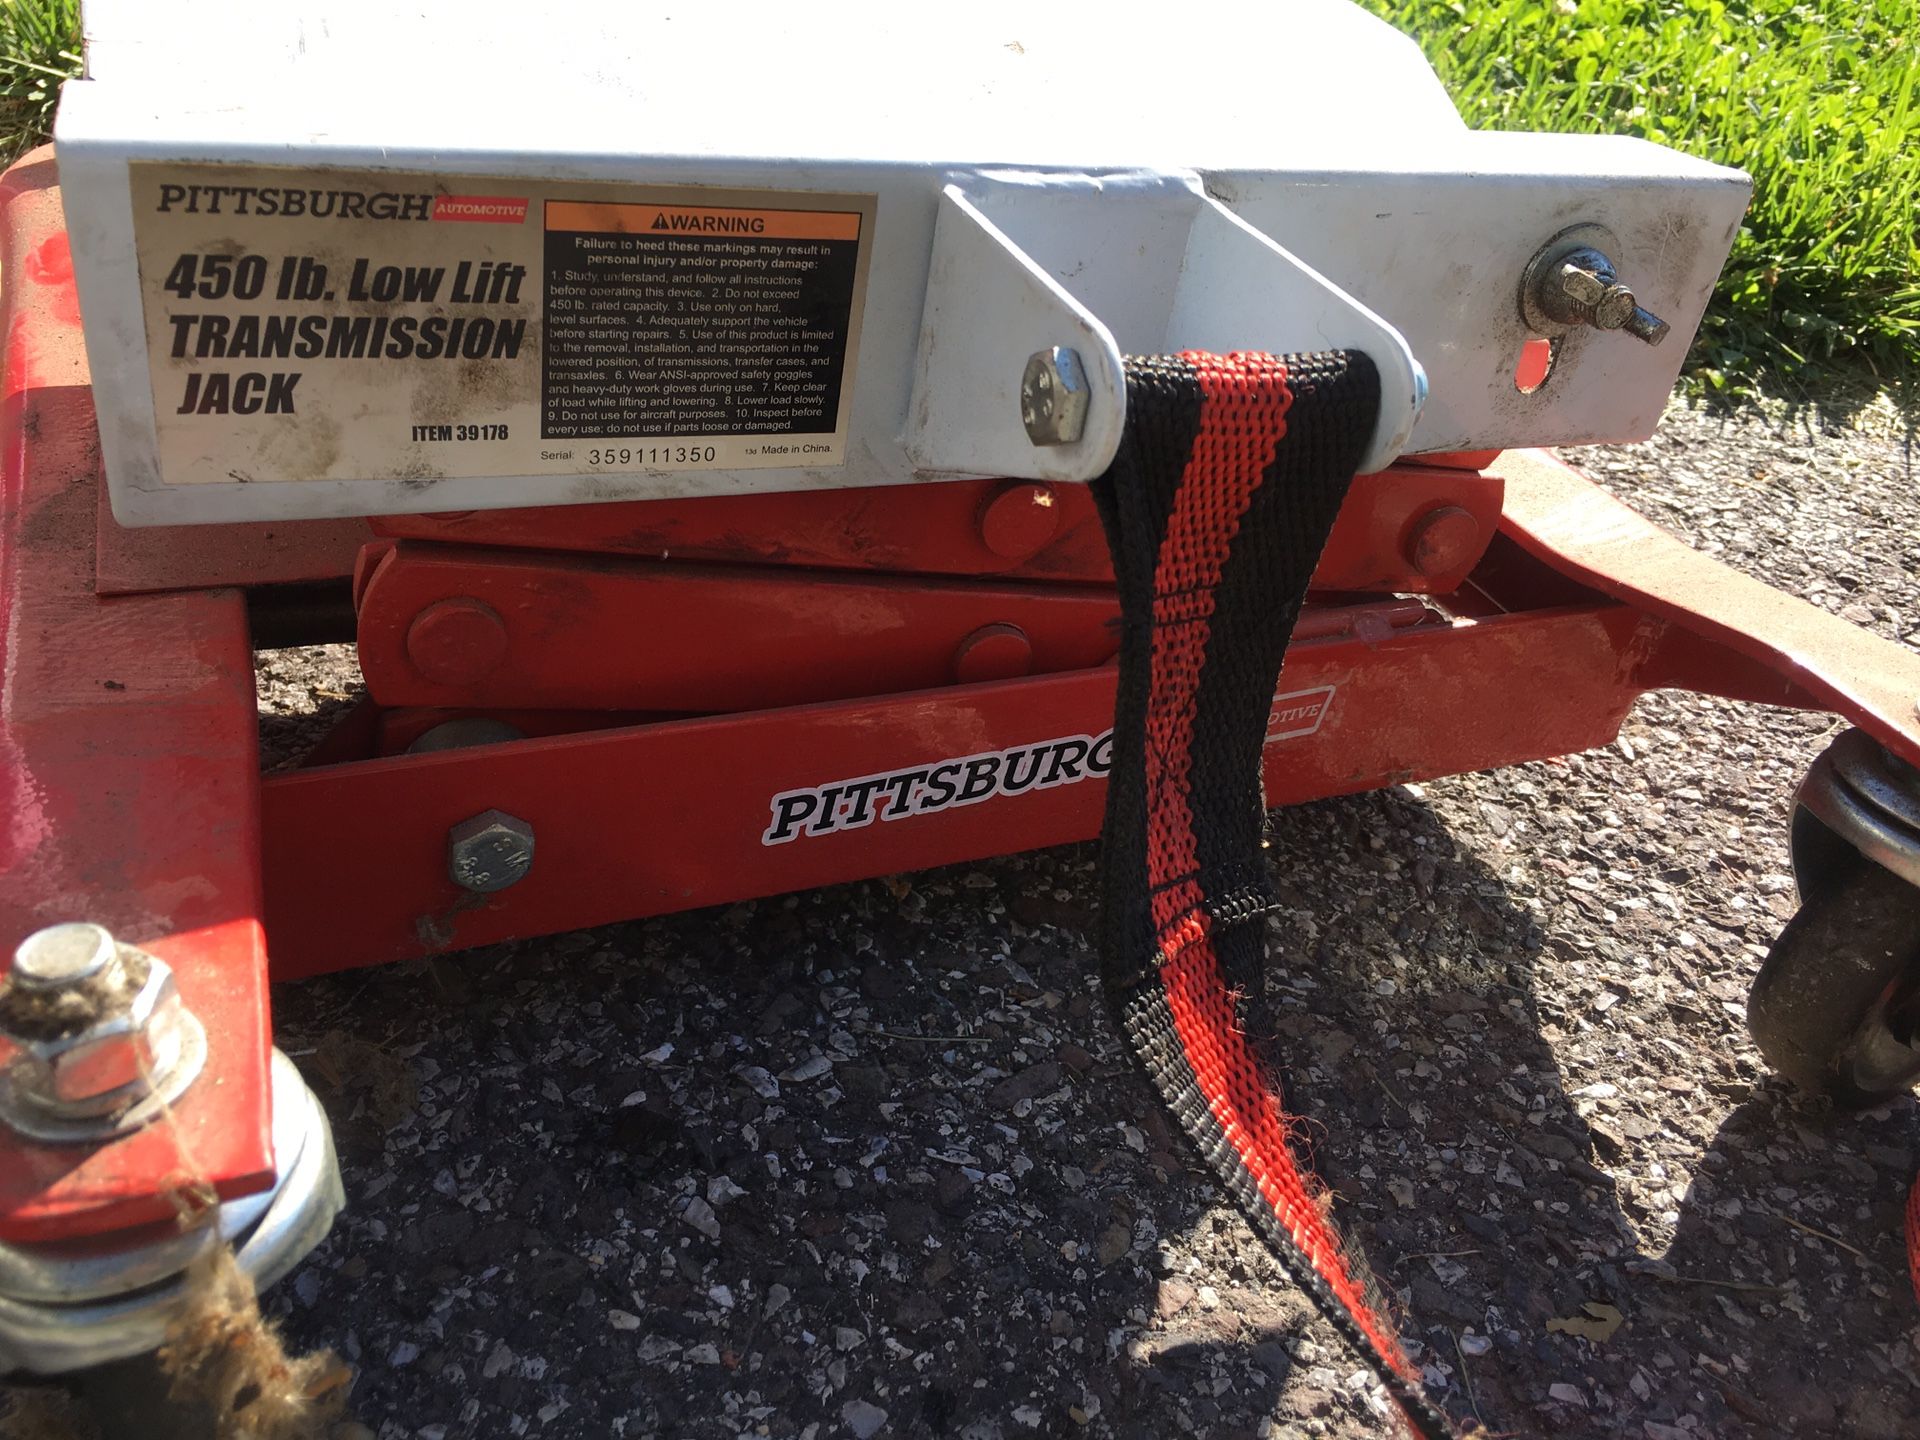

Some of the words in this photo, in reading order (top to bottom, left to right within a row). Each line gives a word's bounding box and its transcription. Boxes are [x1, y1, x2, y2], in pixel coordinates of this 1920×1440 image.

[157, 185, 432, 221] PITTSBURGH
[436, 202, 525, 217] AUTOMOTIVE
[669, 215, 765, 232] WARNING
[575, 238, 617, 249] Failure
[621, 239, 632, 249] to
[636, 239, 665, 252] heed
[668, 241, 700, 252] these
[704, 242, 756, 254] markings
[760, 245, 782, 255] may
[786, 245, 818, 255] result
[821, 246, 830, 254] in
[587, 255, 640, 265] personal
[643, 255, 677, 267] injury
[680, 257, 716, 267] and/or
[720, 259, 767, 269] property
[771, 259, 818, 270] damage:
[164, 255, 268, 300] 450
[276, 257, 334, 301] lb.
[348, 259, 444, 303] Low
[450, 261, 526, 304] Lift
[552, 271, 561, 280] 1.
[603, 271, 668, 284] understand,
[672, 274, 692, 283] and
[696, 274, 725, 284] follow
[729, 274, 741, 284] all
[744, 275, 802, 285] instructions
[551, 286, 586, 295] before
[590, 287, 641, 298] operating
[645, 287, 663, 297] this
[667, 288, 704, 297] device.
[712, 288, 721, 297] 2.
[725, 289, 740, 298] Do
[743, 290, 759, 298] not
[762, 289, 799, 299] exceed
[550, 300, 571, 309] 450
[575, 300, 588, 310] lb.
[592, 300, 620, 310] rated
[624, 301, 670, 313] capacity.
[678, 302, 687, 311] 3.
[691, 302, 711, 311] Use
[715, 303, 736, 314] only
[755, 303, 780, 313] hard,
[550, 315, 576, 324] level
[579, 315, 628, 324] surfaces.
[636, 315, 646, 325] 4.
[649, 315, 708, 327] Adequately
[712, 316, 750, 327] support
[754, 317, 769, 326] the
[773, 317, 808, 326] vehicle
[169, 315, 526, 359] TRANSMISSION
[550, 329, 585, 339] before
[589, 329, 628, 341] starting
[632, 330, 670, 341] repairs.
[679, 330, 689, 339] 5.
[692, 330, 713, 339] Use
[716, 330, 726, 339] of
[729, 330, 746, 339] this
[750, 331, 787, 342] product
[791, 331, 798, 340] is
[802, 331, 834, 340] limited
[550, 344, 559, 353] to
[563, 343, 580, 352] the
[584, 343, 631, 354] removal,
[634, 343, 694, 354] installation,
[697, 343, 716, 352] and
[719, 343, 788, 355] transportation
[792, 344, 801, 352] in
[804, 344, 819, 352] the
[549, 357, 592, 366] lowered
[596, 357, 640, 369] position,
[644, 357, 654, 366] of
[657, 357, 731, 367] transmissions,
[735, 357, 773, 366] transfer
[776, 358, 808, 367] cases,
[811, 357, 829, 365] and
[549, 371, 608, 380] transaxles.
[615, 370, 624, 379] 6.
[628, 370, 656, 379] Wear
[659, 370, 738, 381] ANSI-approved
[741, 370, 771, 381] safety
[774, 370, 812, 381] goggles
[177, 372, 302, 415] JACK
[549, 384, 569, 393] and
[573, 384, 631, 396] heavy-duty
[635, 383, 659, 393] work
[663, 383, 696, 394] gloves
[700, 383, 731, 395] during
[735, 385, 755, 393] use.
[774, 383, 800, 393] Keep
[803, 382, 826, 391] clear
[548, 398, 559, 407] of
[562, 398, 585, 407] load
[589, 397, 615, 406] while
[619, 397, 647, 408] lifting
[650, 397, 669, 406] and
[673, 396, 718, 408] lowering.
[737, 396, 767, 405] Lower
[771, 395, 791, 404] load
[794, 395, 825, 407] slowly.
[548, 411, 558, 421] 9.
[562, 411, 577, 421] Do
[581, 411, 597, 420] not
[601, 412, 620, 420] use
[623, 410, 637, 420] for
[640, 410, 676, 419] aircraft
[679, 411, 727, 422] purposes.
[736, 410, 750, 418] 10.
[754, 409, 789, 420] Inspect
[792, 408, 822, 417] before
[412, 425, 453, 441] ITEM
[457, 424, 508, 441] 39178
[548, 426, 578, 436] every
[607, 424, 621, 433] do
[624, 424, 639, 432] not
[664, 423, 671, 432] if
[674, 423, 698, 433] parts
[702, 422, 729, 431] loose
[745, 421, 793, 432] damaged.
[541, 451, 574, 460] Serial:
[589, 447, 716, 465] 359111350
[762, 446, 788, 454] Made
[792, 446, 800, 454] in
[803, 444, 832, 453] China.
[769, 733, 1114, 839] PITTSBURG
[1267, 704, 1320, 727] OTIVE
